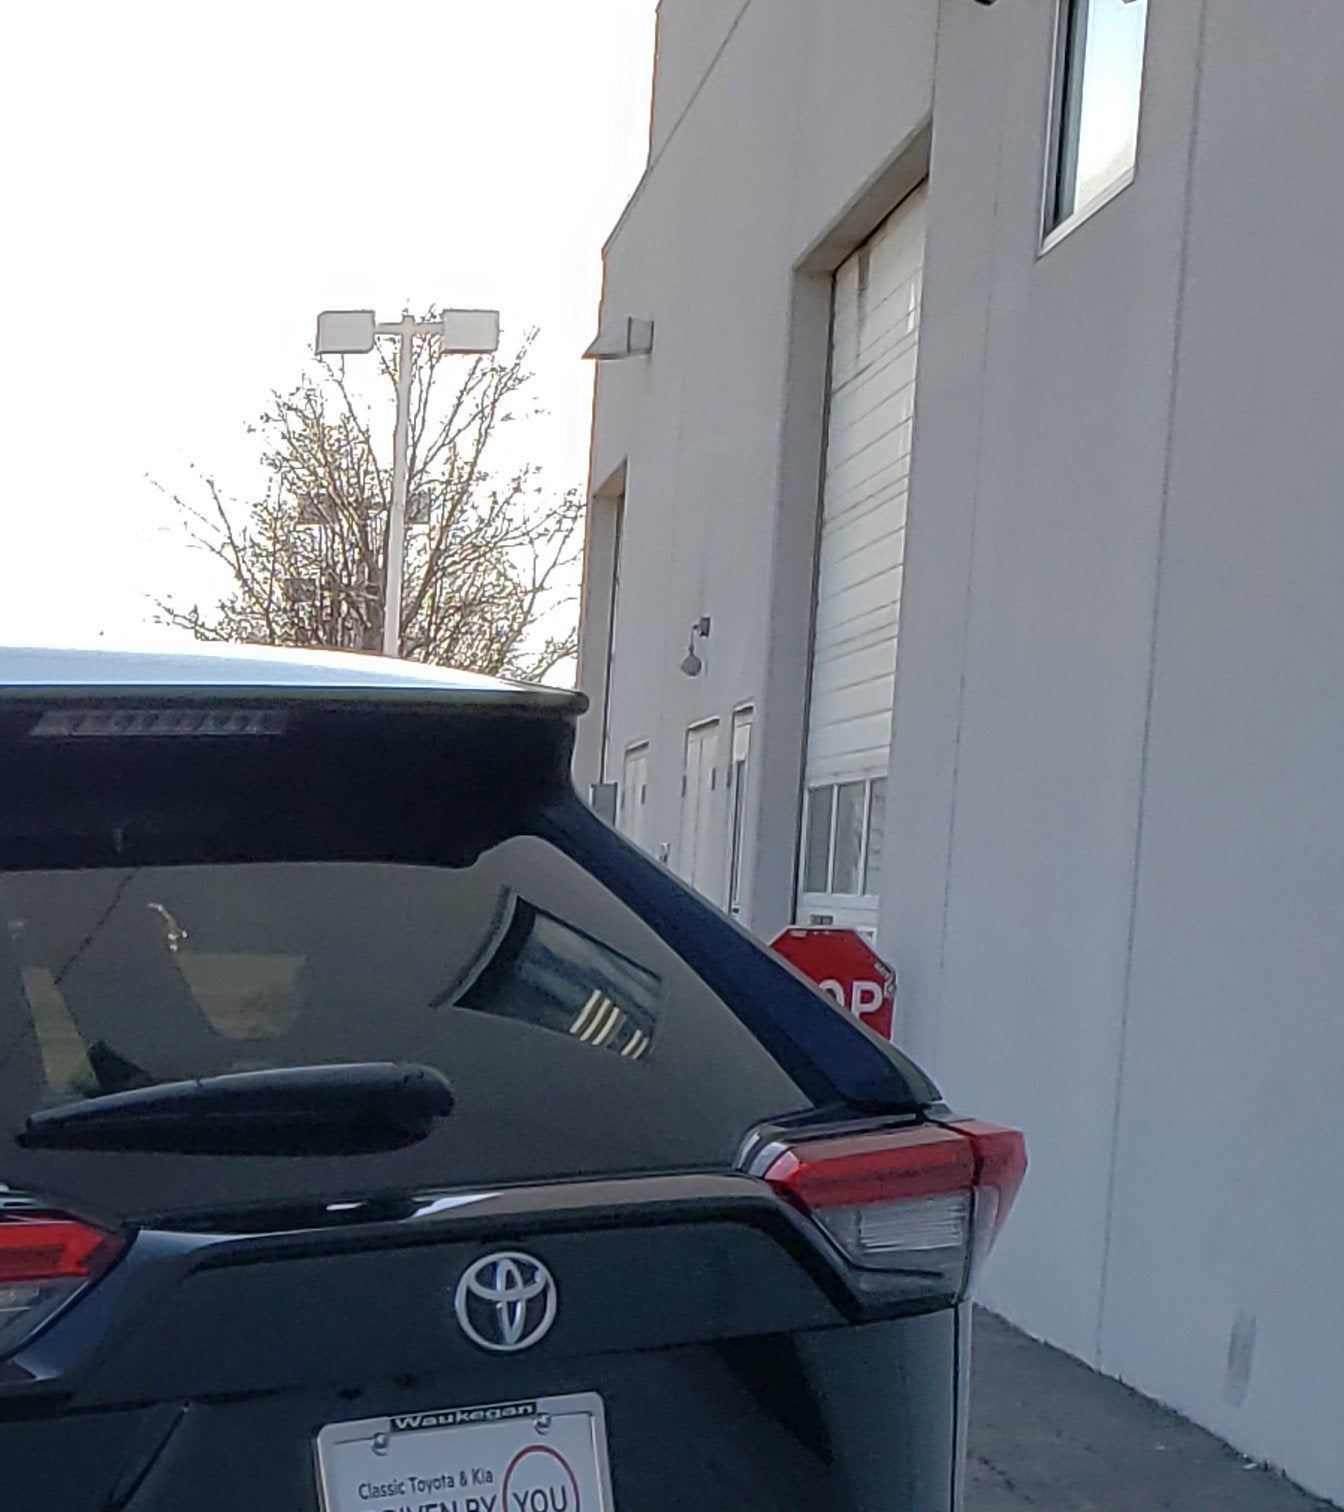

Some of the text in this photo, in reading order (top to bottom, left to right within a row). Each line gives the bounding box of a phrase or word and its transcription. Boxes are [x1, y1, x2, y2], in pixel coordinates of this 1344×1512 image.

[394, 1403, 534, 1430] Waukegan
[358, 1467, 494, 1501] Classic Toyota & Kia
